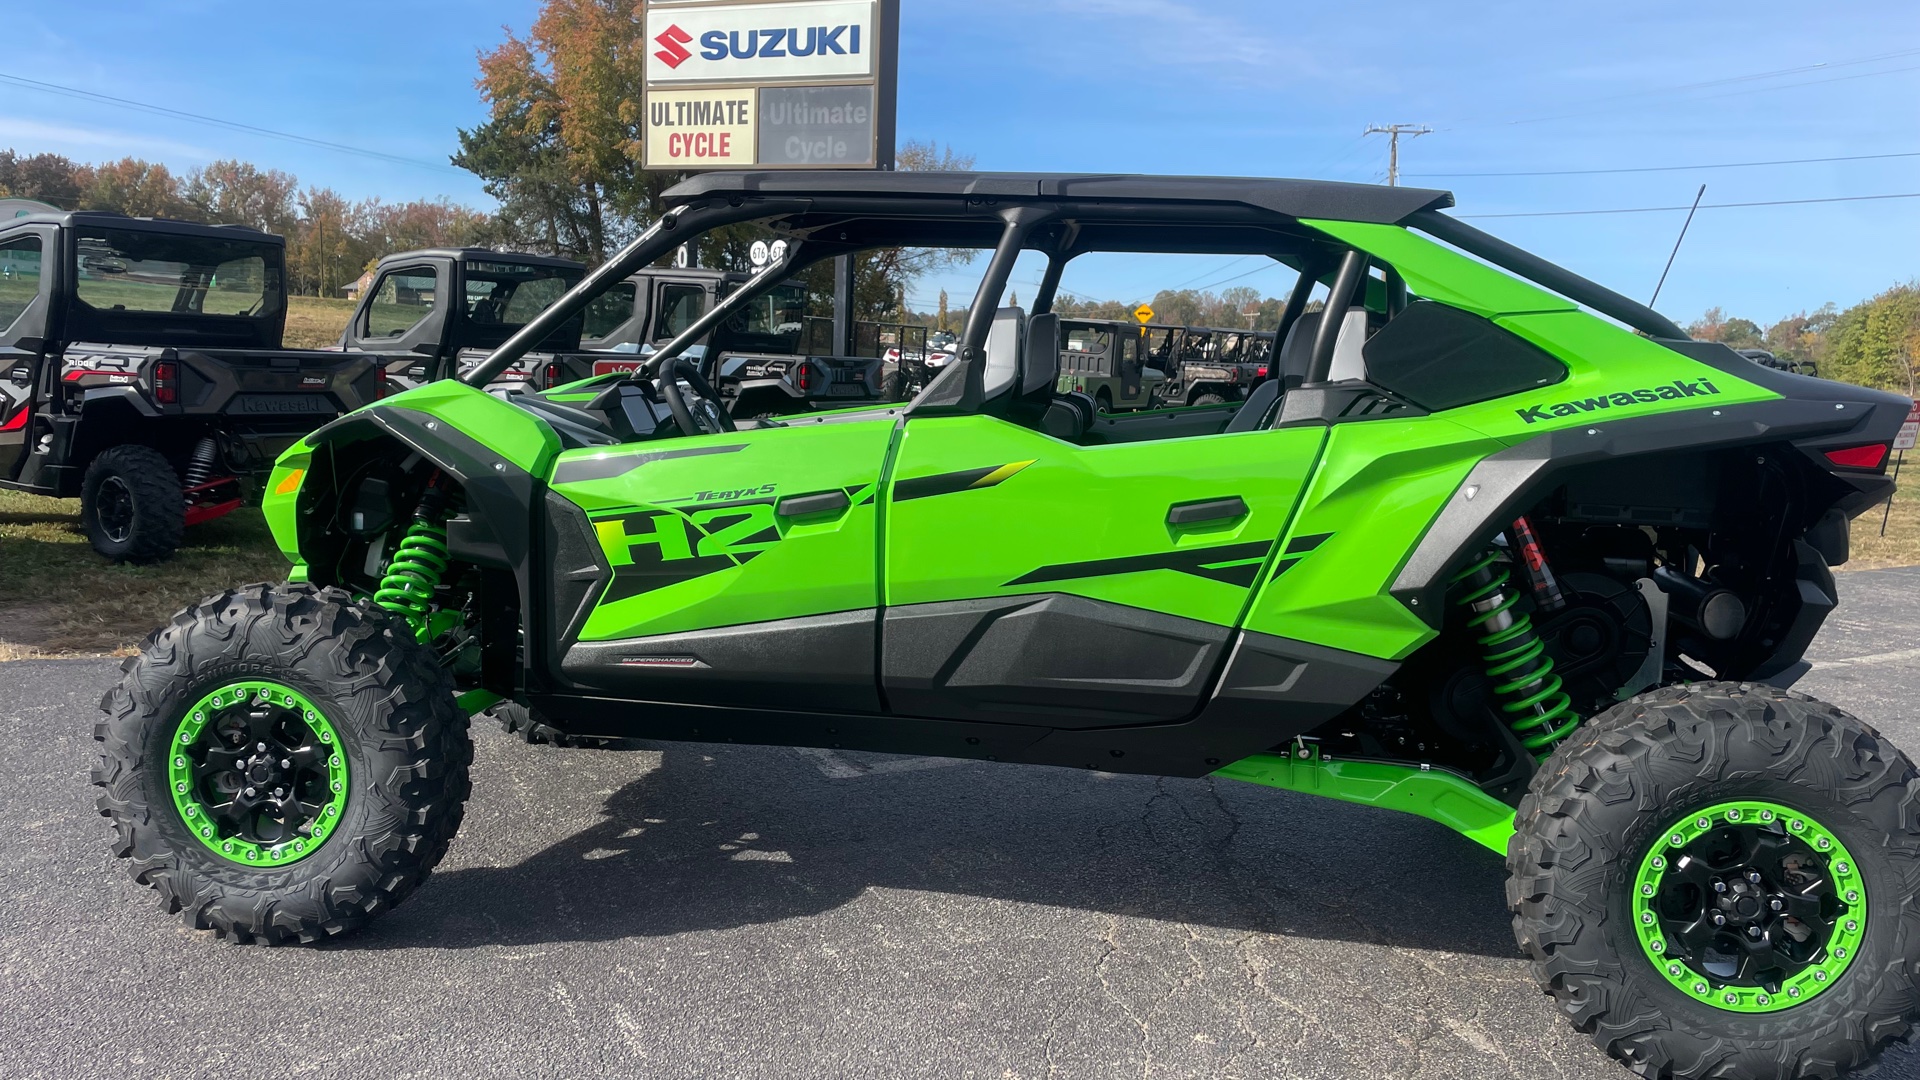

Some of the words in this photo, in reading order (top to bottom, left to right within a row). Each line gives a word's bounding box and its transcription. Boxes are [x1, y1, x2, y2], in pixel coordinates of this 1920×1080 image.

[700, 25, 860, 60] SUZUKI
[651, 100, 749, 127] ULTIMATE
[769, 102, 867, 126] Ultimate
[669, 133, 731, 158] CYCLE
[785, 135, 848, 163] Cycle
[752, 247, 766, 259] 676
[69, 359, 95, 367] RIDGE
[242, 397, 320, 412] Kawasaki
[1515, 378, 1720, 424] Kawasaki
[593, 503, 784, 566] H2
[177, 663, 273, 699] CARNIVORE
